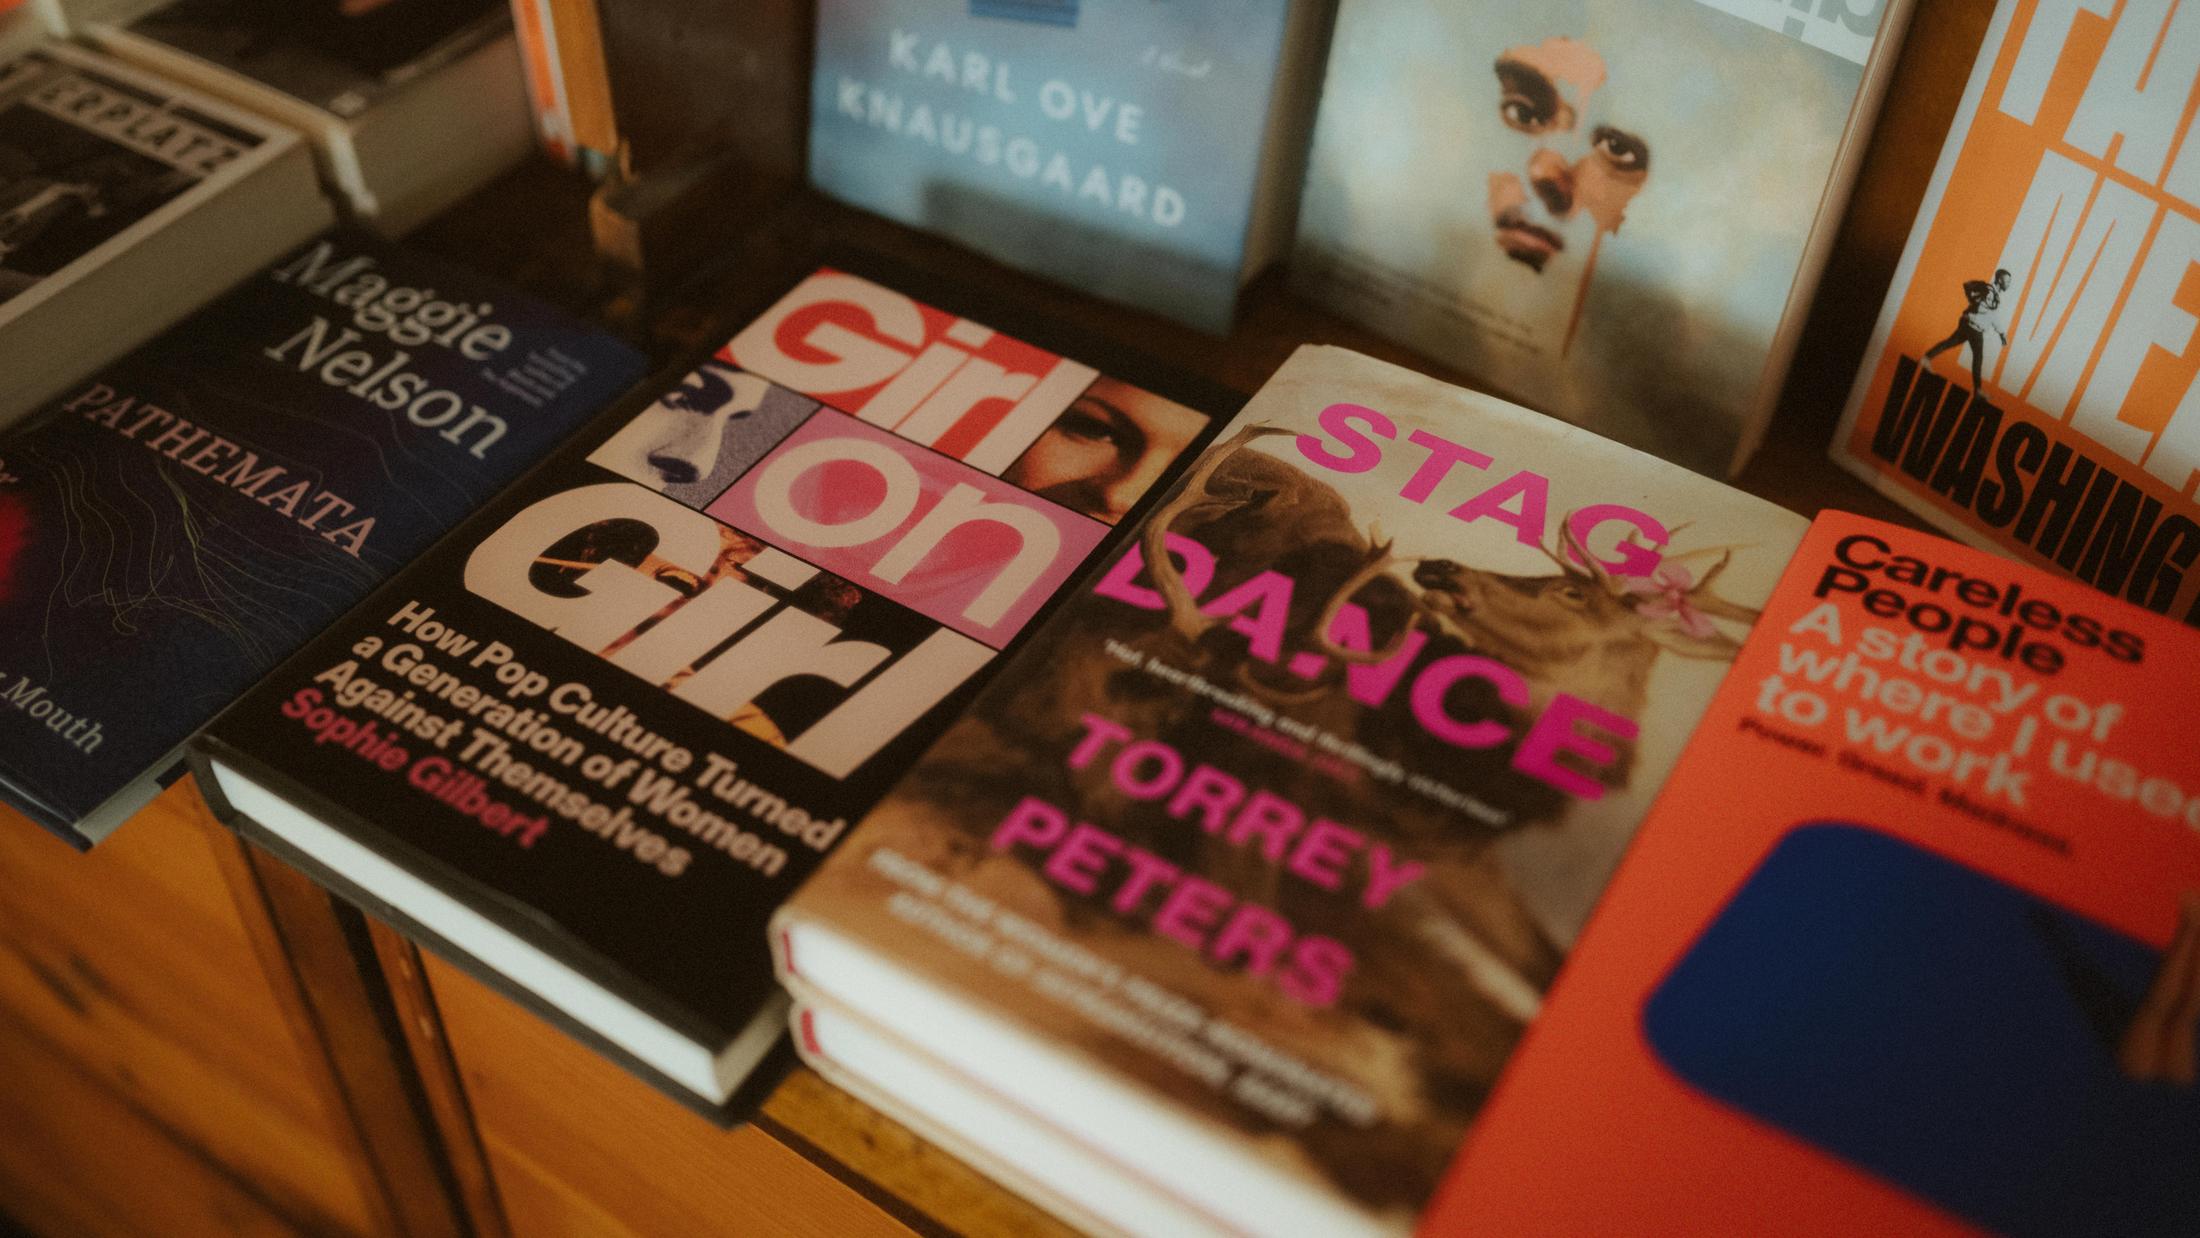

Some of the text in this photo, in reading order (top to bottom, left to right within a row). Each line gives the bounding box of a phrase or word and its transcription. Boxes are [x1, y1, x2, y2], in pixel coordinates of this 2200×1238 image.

[836, 76, 1188, 227] KNAUSGAARD
[888, 28, 1148, 145] KARL OVE
[264, 317, 508, 460] Nelson
[273, 241, 511, 361] Maggie
[727, 272, 1100, 476] Girl
[64, 384, 377, 559] PATHEMATA
[754, 438, 1061, 629] on
[1296, 402, 1671, 578] STAG
[1870, 354, 2200, 630] WASHING
[464, 482, 998, 780] Girl
[1093, 532, 1640, 801] DANCE
[1790, 602, 2124, 742] A story of
[1812, 564, 2065, 675] People
[1834, 534, 2146, 664] Careless
[0, 676, 104, 754] Mouth
[281, 687, 550, 849] Sophie Gilbert
[314, 659, 692, 878] Against Themselves
[352, 635, 789, 878] a Generation of Women
[387, 600, 847, 852] How Pop Culture Turned
[1757, 674, 1828, 726] to
[1845, 708, 2031, 806] work
[1779, 643, 1994, 740] where
[2012, 715, 2038, 757] I
[1066, 713, 1426, 908] TORREY
[991, 797, 1355, 1007] PETERS
